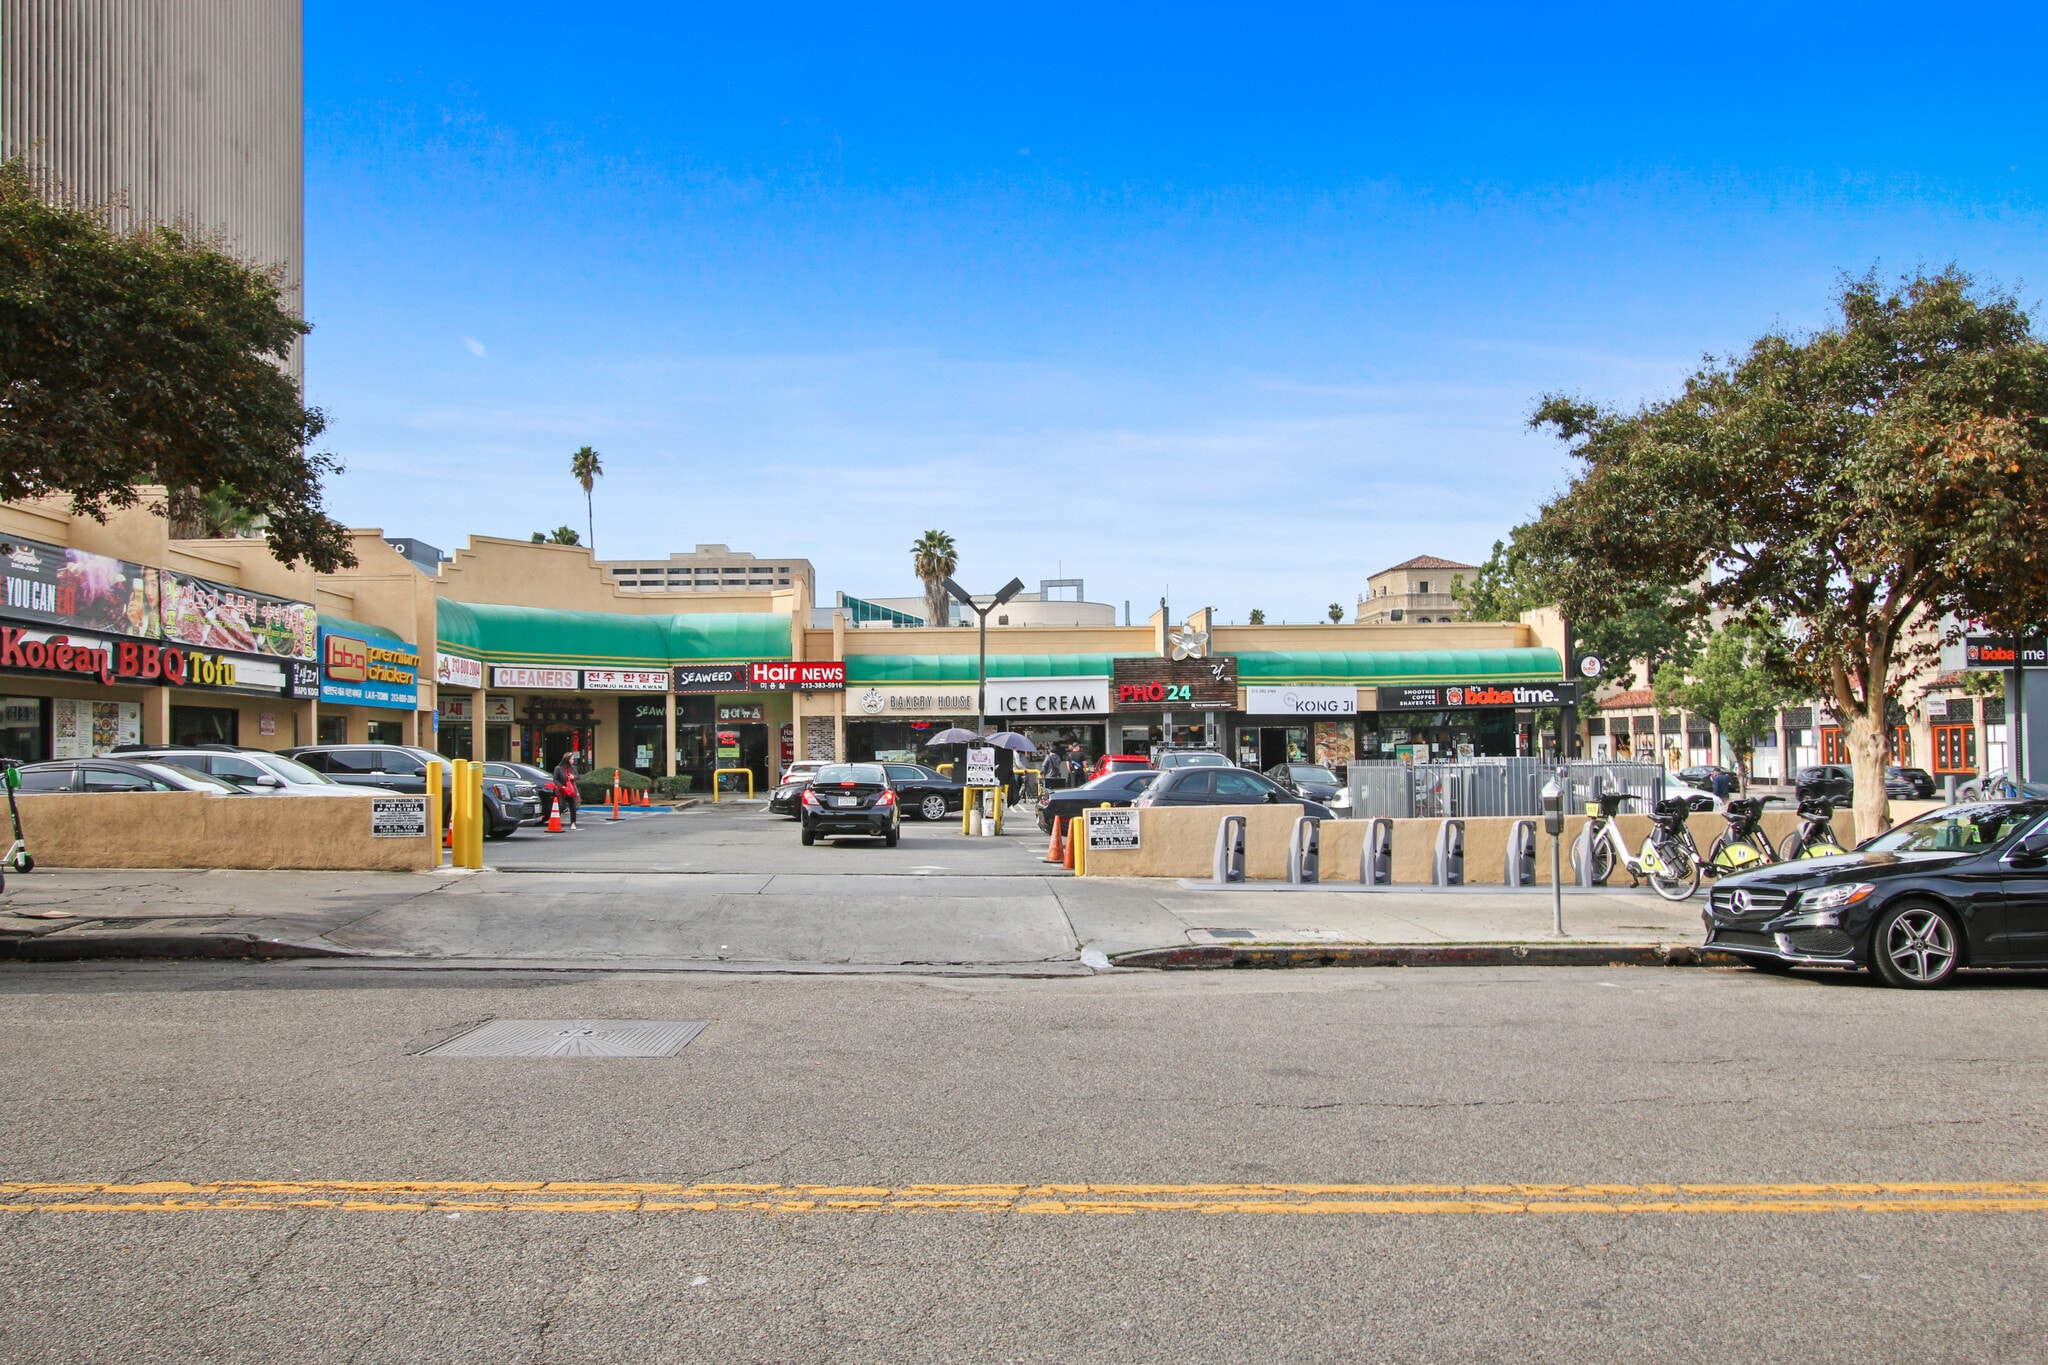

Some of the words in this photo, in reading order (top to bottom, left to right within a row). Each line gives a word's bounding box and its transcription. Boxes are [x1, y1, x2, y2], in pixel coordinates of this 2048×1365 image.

[6, 576, 30, 608] YOU
[32, 581, 55, 613] CAN
[56, 586, 76, 616] EAT
[164, 577, 178, 636] 마포
[181, 582, 218, 613] 생고기
[261, 601, 301, 629] 양념갈비
[303, 607, 314, 657] MAPO
[1, 626, 115, 686] Korean
[118, 641, 185, 686] BBQ
[189, 651, 236, 686] Tofu
[369, 647, 422, 667] premium
[299, 663, 319, 686] 생고기
[368, 664, 414, 685] chicken
[452, 658, 460, 673] 213
[460, 660, 469, 675] 800
[469, 662, 480, 677] 2004
[753, 664, 797, 681] Hair
[802, 668, 843, 680] NEWS
[499, 669, 573, 687] CLEANERS
[587, 672, 616, 682] 전주
[623, 673, 666, 684] 한일관
[681, 671, 732, 686] SEAWEED
[760, 682, 786, 690] 미용실
[294, 686, 307, 695] MAPO
[308, 687, 319, 697] KOGI
[1167, 685, 1192, 700] 24
[890, 696, 932, 709] BAKERY
[938, 696, 972, 709] HOUSE
[1000, 697, 1028, 712] ICE
[1035, 696, 1096, 711] CREAM
[1295, 700, 1338, 712] KONG
[1343, 701, 1354, 712] JI
[635, 706, 684, 718] SEAWD
